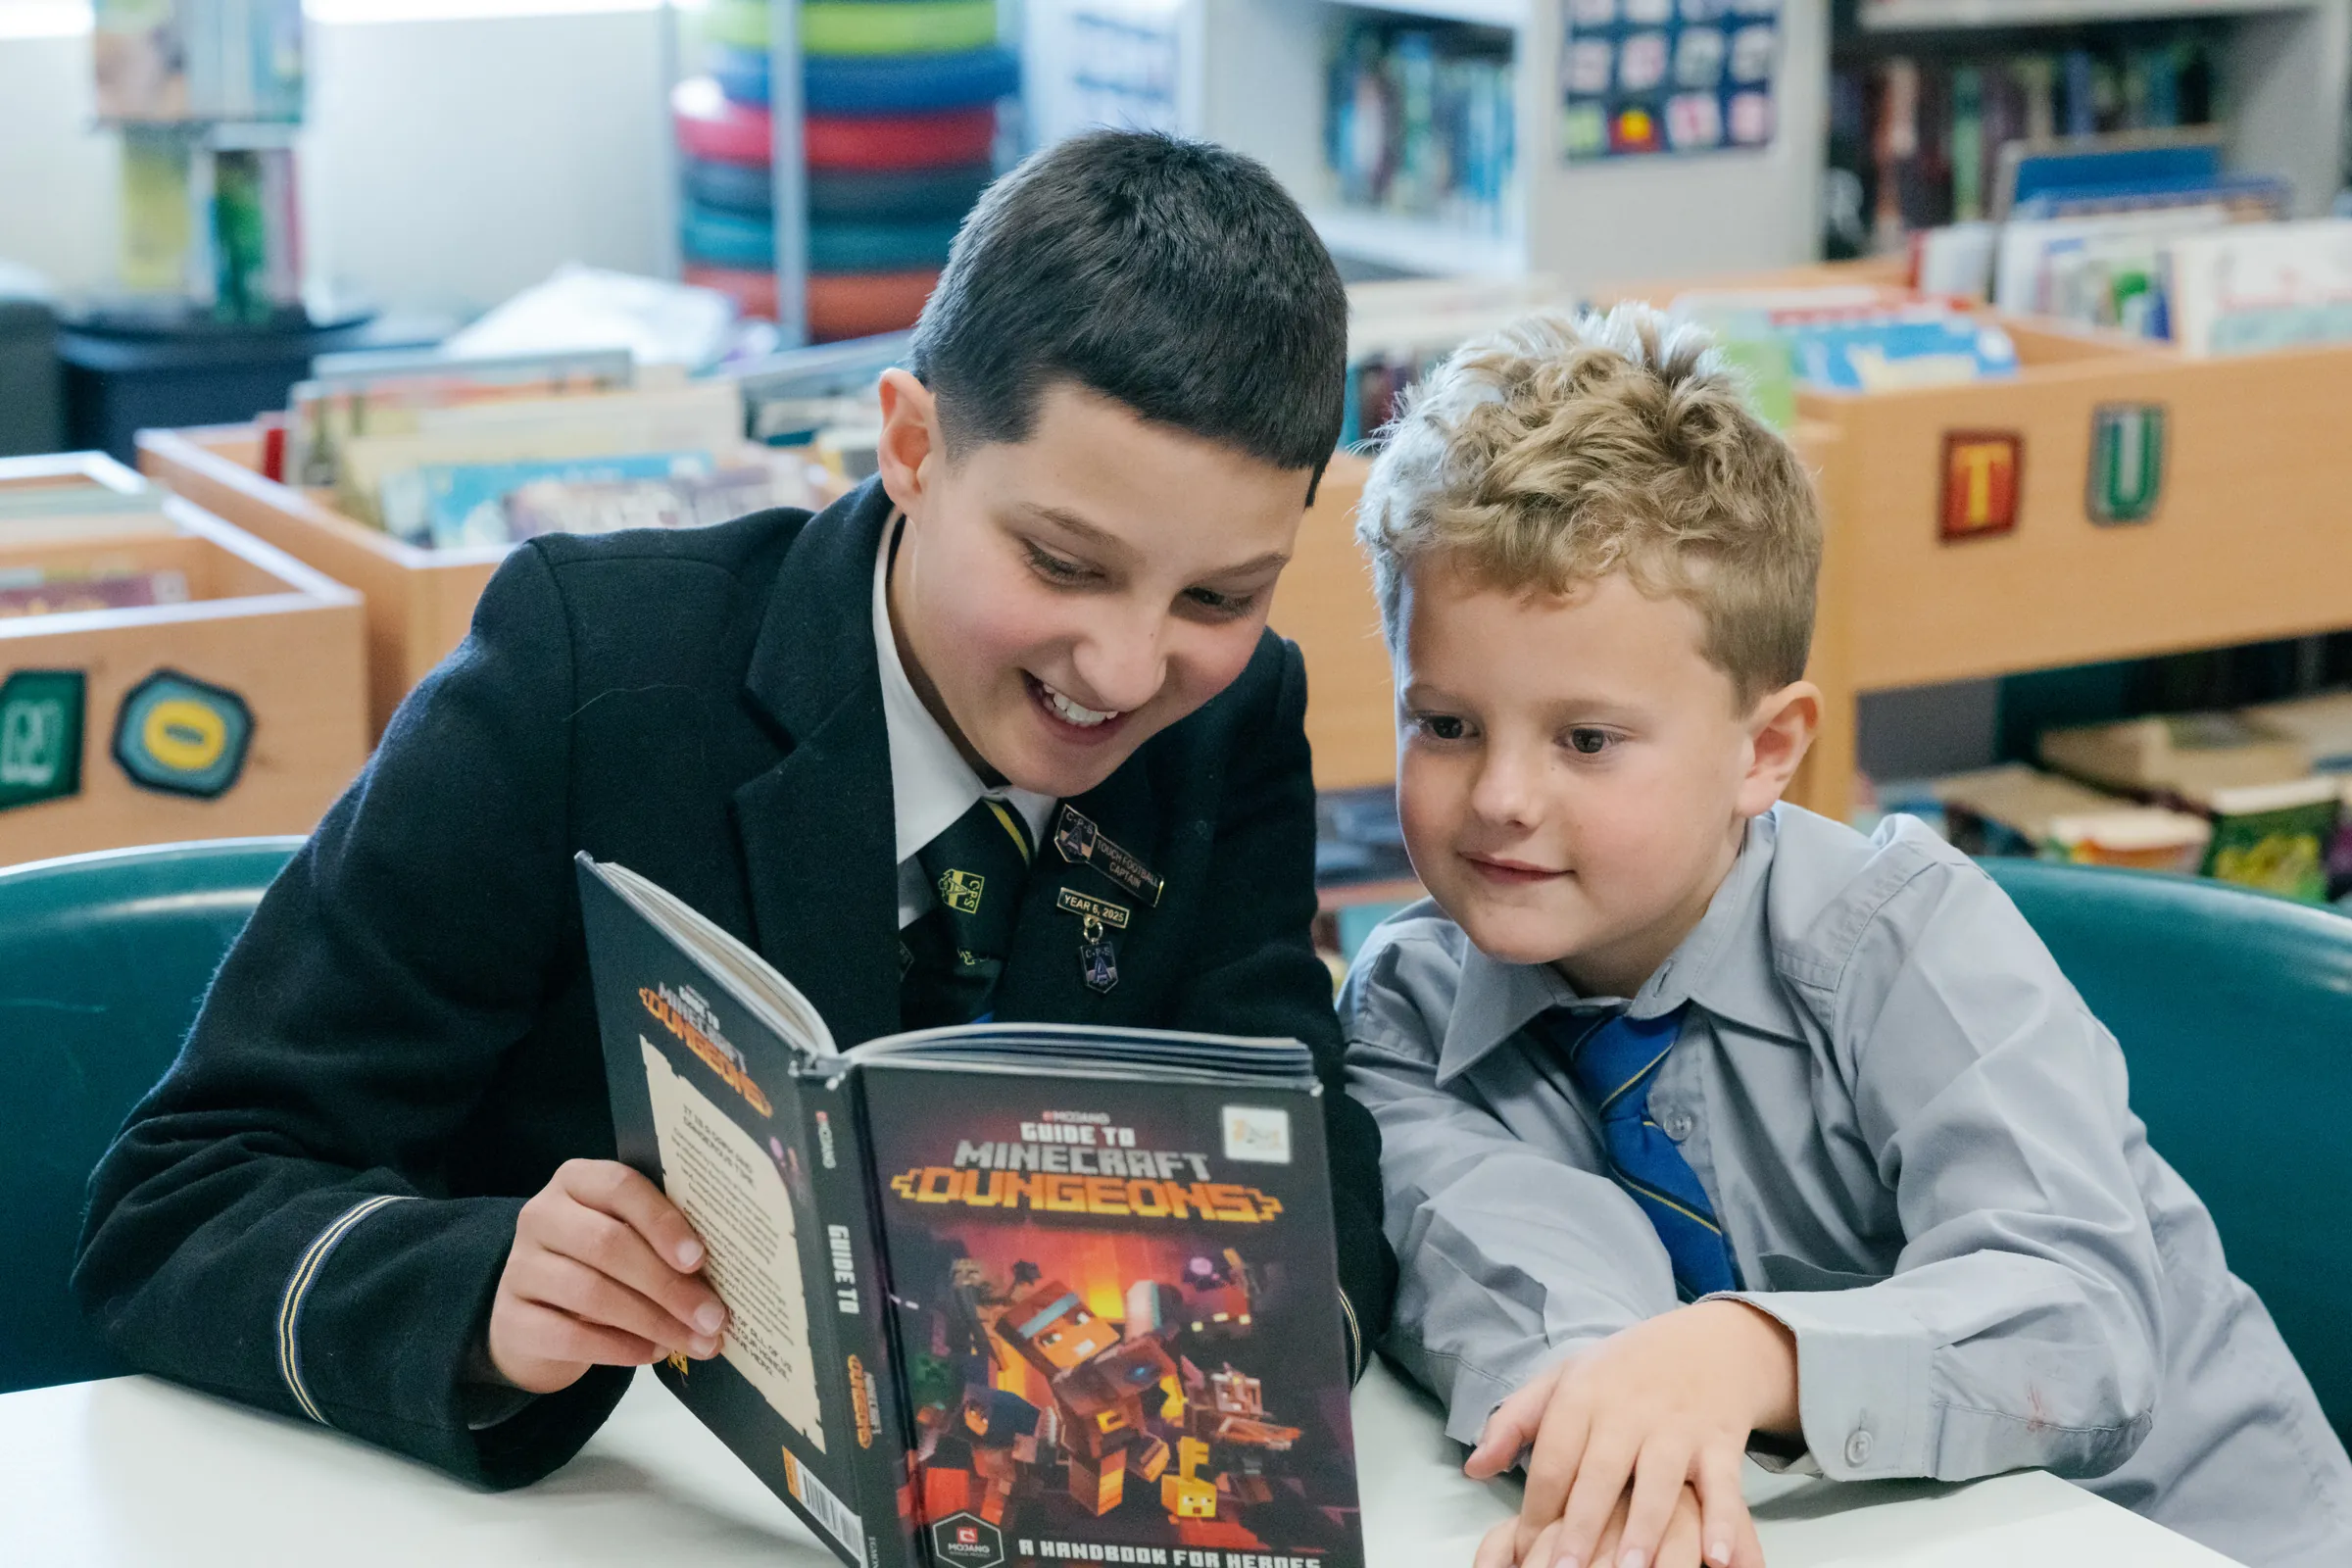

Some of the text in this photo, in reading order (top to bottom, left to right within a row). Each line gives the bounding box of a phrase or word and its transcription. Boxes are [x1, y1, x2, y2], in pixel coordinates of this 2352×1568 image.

[1951, 443, 2014, 527] T
[2094, 405, 2164, 527] U
[145, 700, 225, 770] O
[1098, 839, 1160, 888] TOUCH FOOTBALL
[1109, 862, 1142, 889] CAPTAIN
[1064, 894, 1091, 911] YEAR
[1102, 907, 1125, 923] 2025
[1020, 1122, 1136, 1148] GUIDE TO
[953, 1139, 1211, 1182] MINECRAFT
[906, 1165, 1272, 1224] DUNGEONS
[828, 1224, 859, 1314] GUIDE TO
[948, 1543, 990, 1554] MOJANG
[1018, 1539, 1321, 1568] A HANDBOOK FOR HEROES
